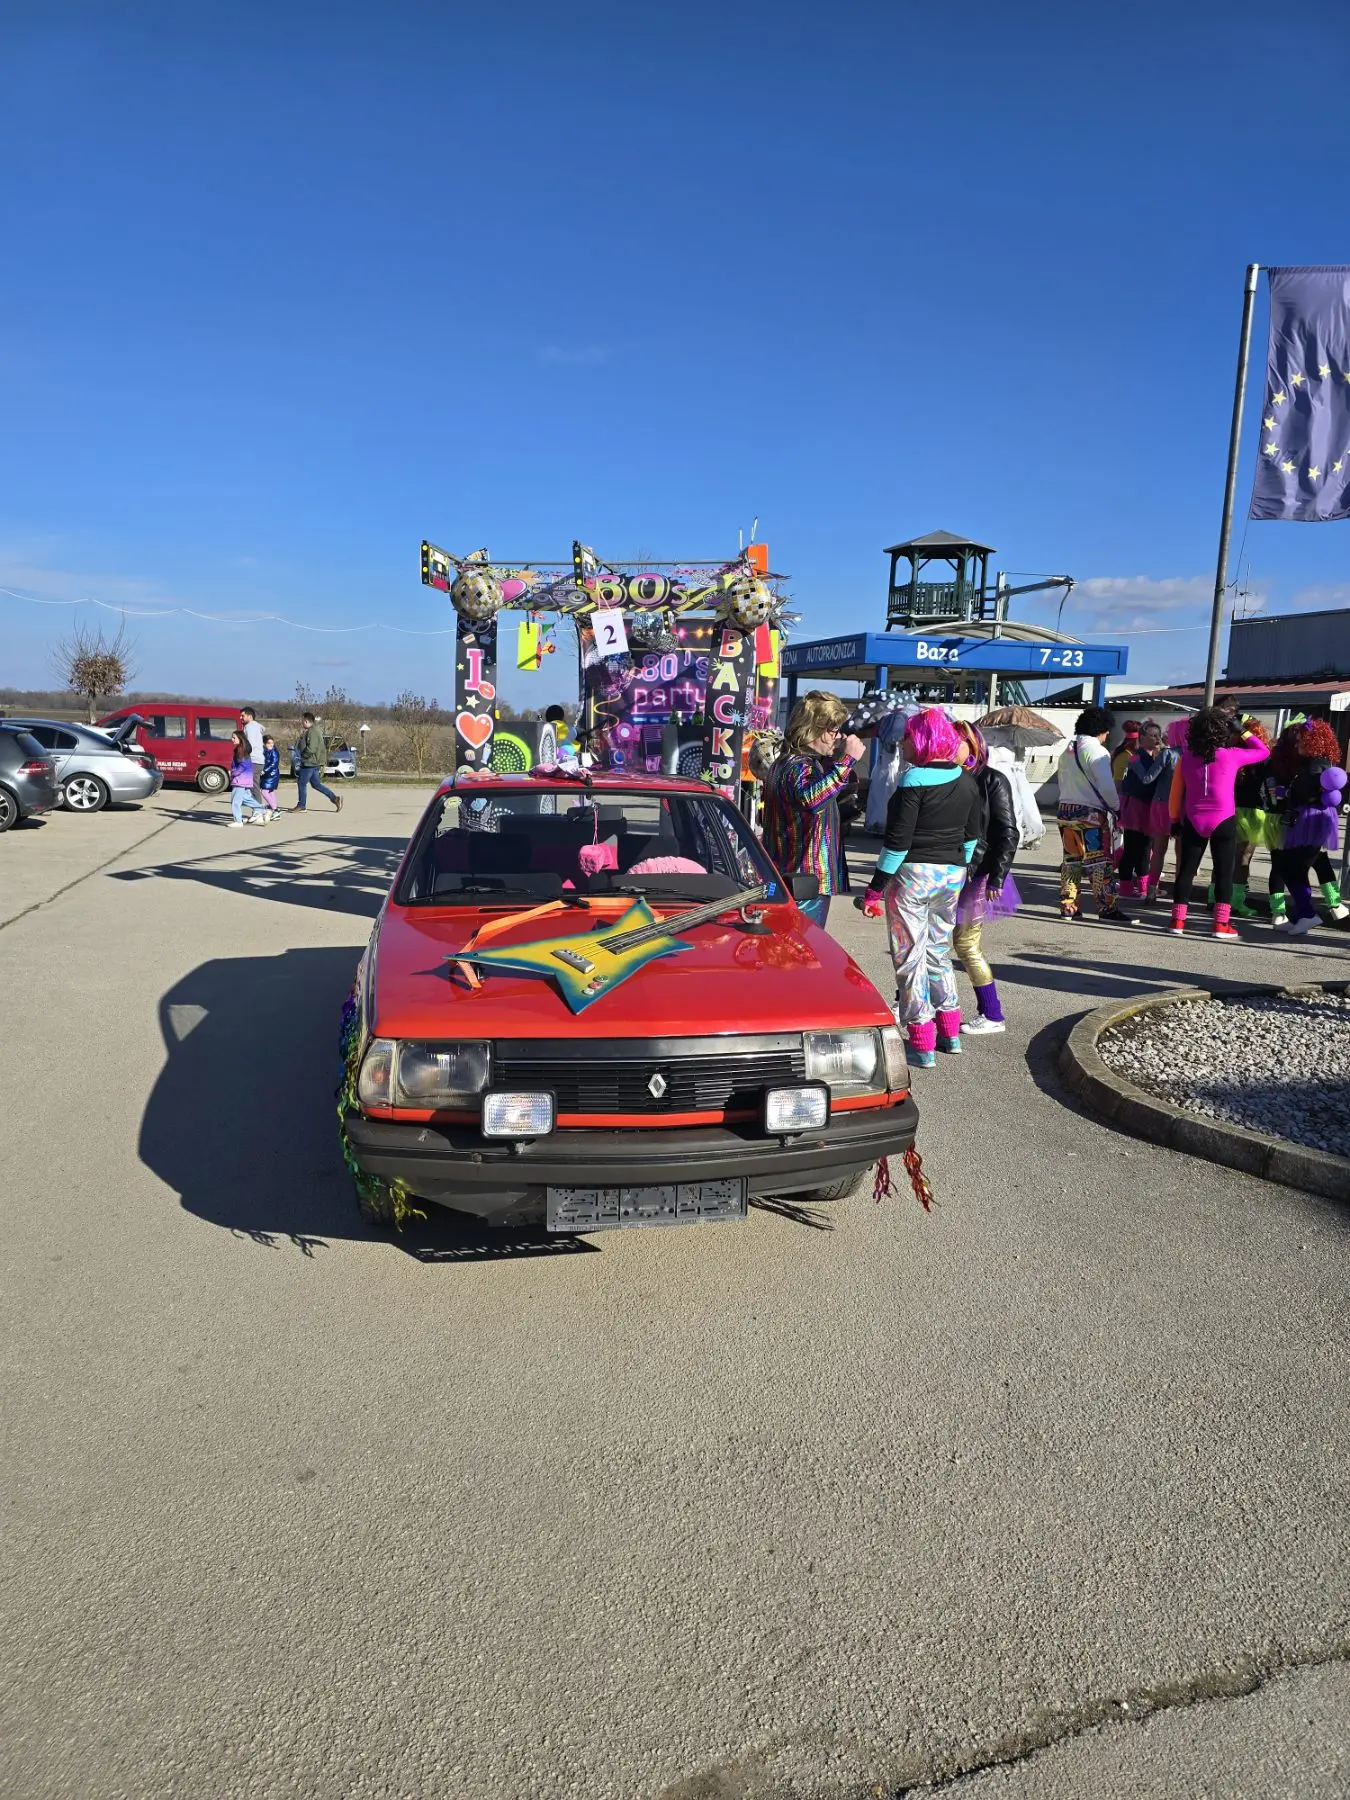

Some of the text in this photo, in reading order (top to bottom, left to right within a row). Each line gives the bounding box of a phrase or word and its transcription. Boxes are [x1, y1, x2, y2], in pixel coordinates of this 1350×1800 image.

[603, 625, 617, 645] 2
[806, 642, 856, 662] AUTOPRAONICA
[916, 641, 1084, 667] Baza 7-23
[464, 648, 485, 690] I
[642, 650, 709, 681] 80's
[634, 681, 707, 715] party
[709, 762, 733, 779] TO
